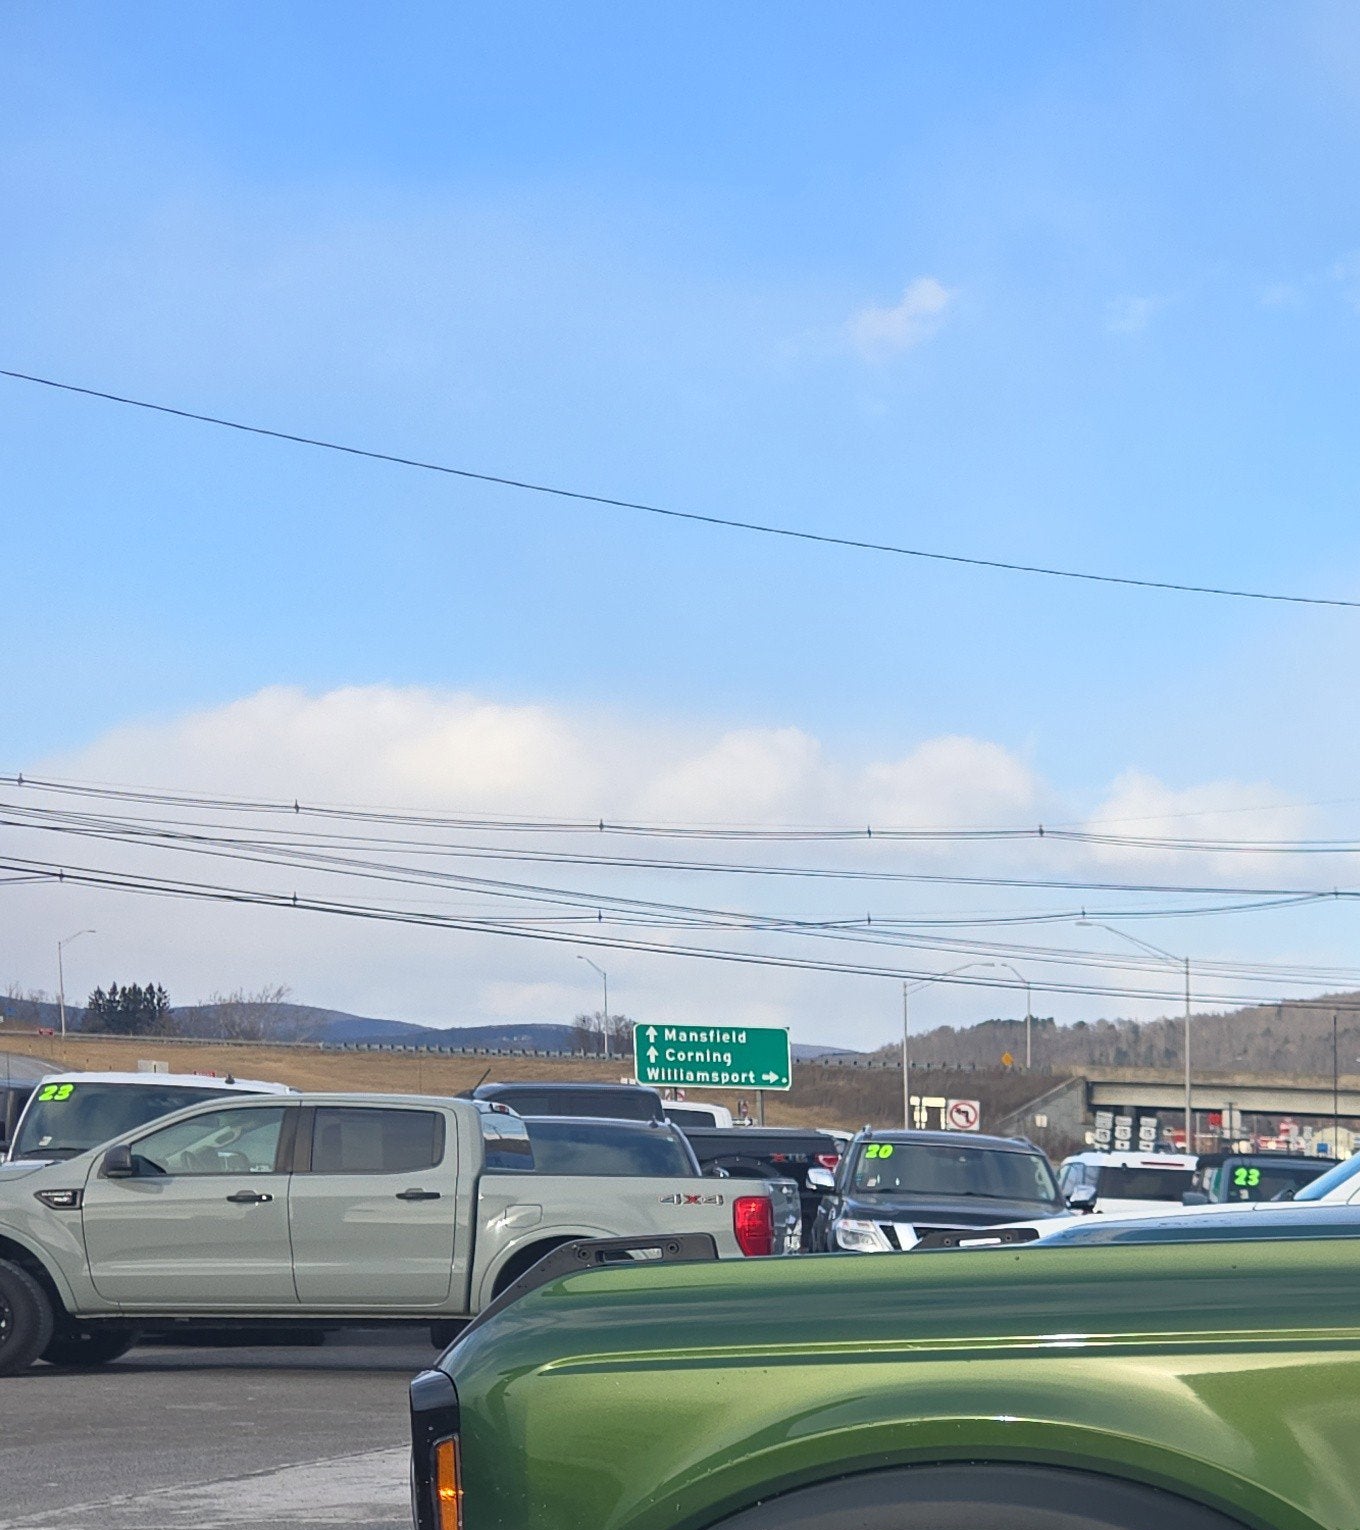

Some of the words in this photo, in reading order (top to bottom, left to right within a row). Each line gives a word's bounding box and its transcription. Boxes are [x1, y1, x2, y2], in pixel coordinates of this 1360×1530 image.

[664, 1028, 747, 1044] Mansfield
[665, 1048, 732, 1067] Corning
[647, 1067, 755, 1085] Williamsport
[38, 1084, 74, 1101] 23
[865, 1143, 893, 1159] 20
[1234, 1167, 1260, 1186] 23
